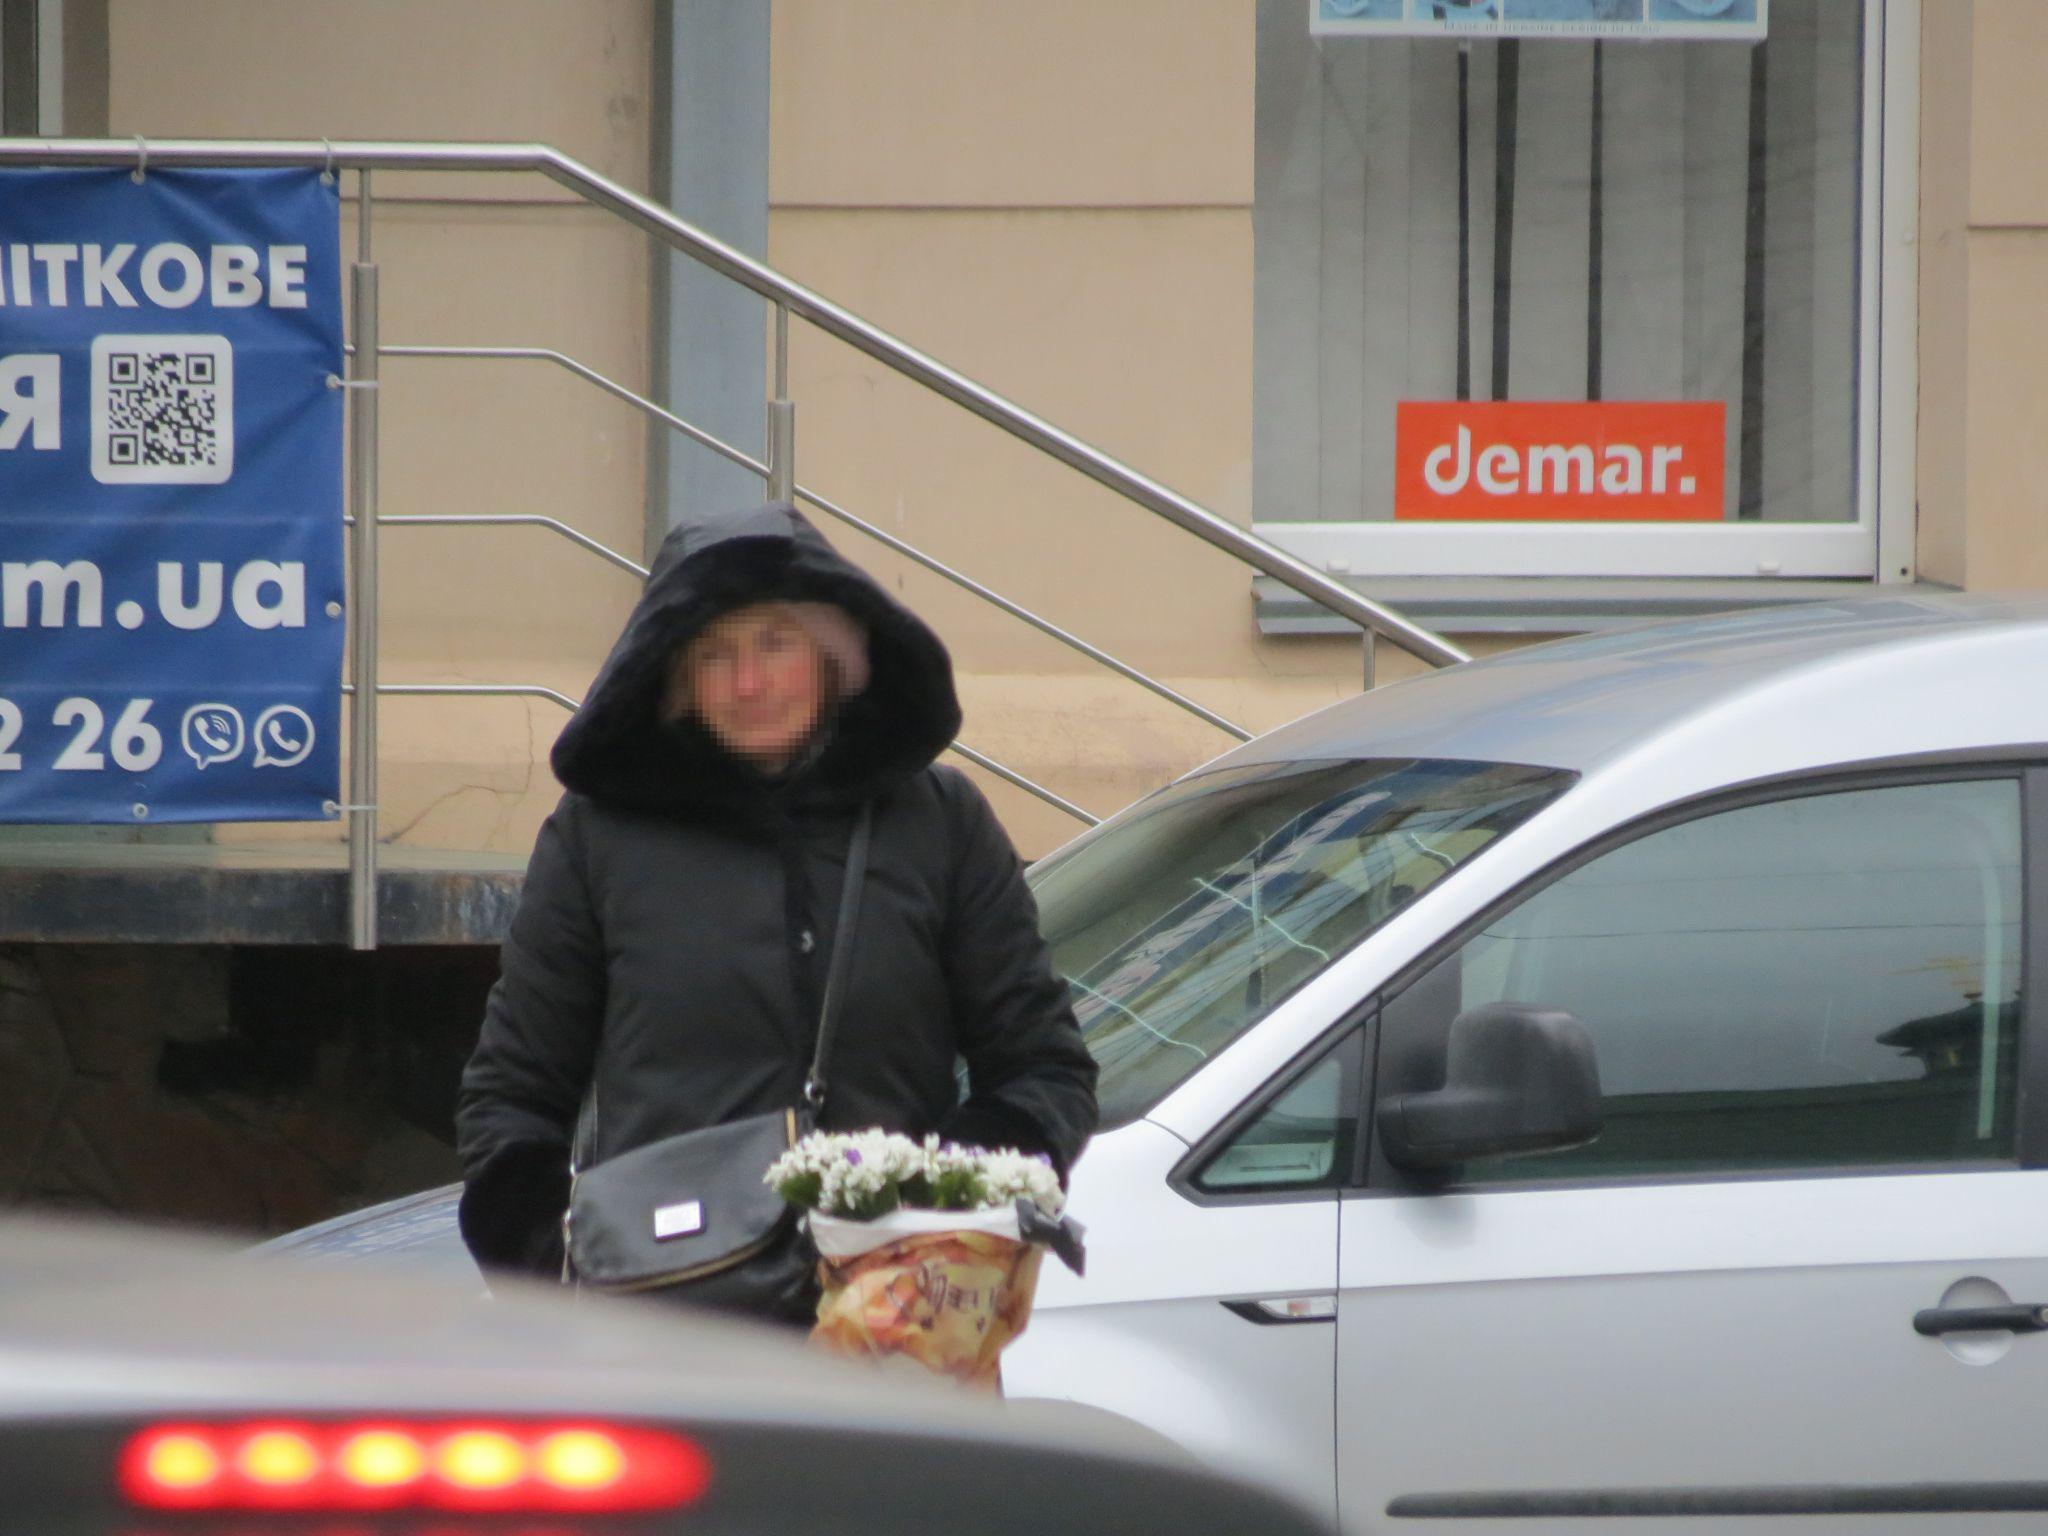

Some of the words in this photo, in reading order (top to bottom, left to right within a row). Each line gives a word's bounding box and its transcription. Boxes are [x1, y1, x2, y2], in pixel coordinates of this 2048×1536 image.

[0, 243, 307, 309] ІТКОВЕ
[1424, 424, 1696, 495] demar.
[2, 560, 306, 630] m.ua
[52, 697, 163, 772] 26
